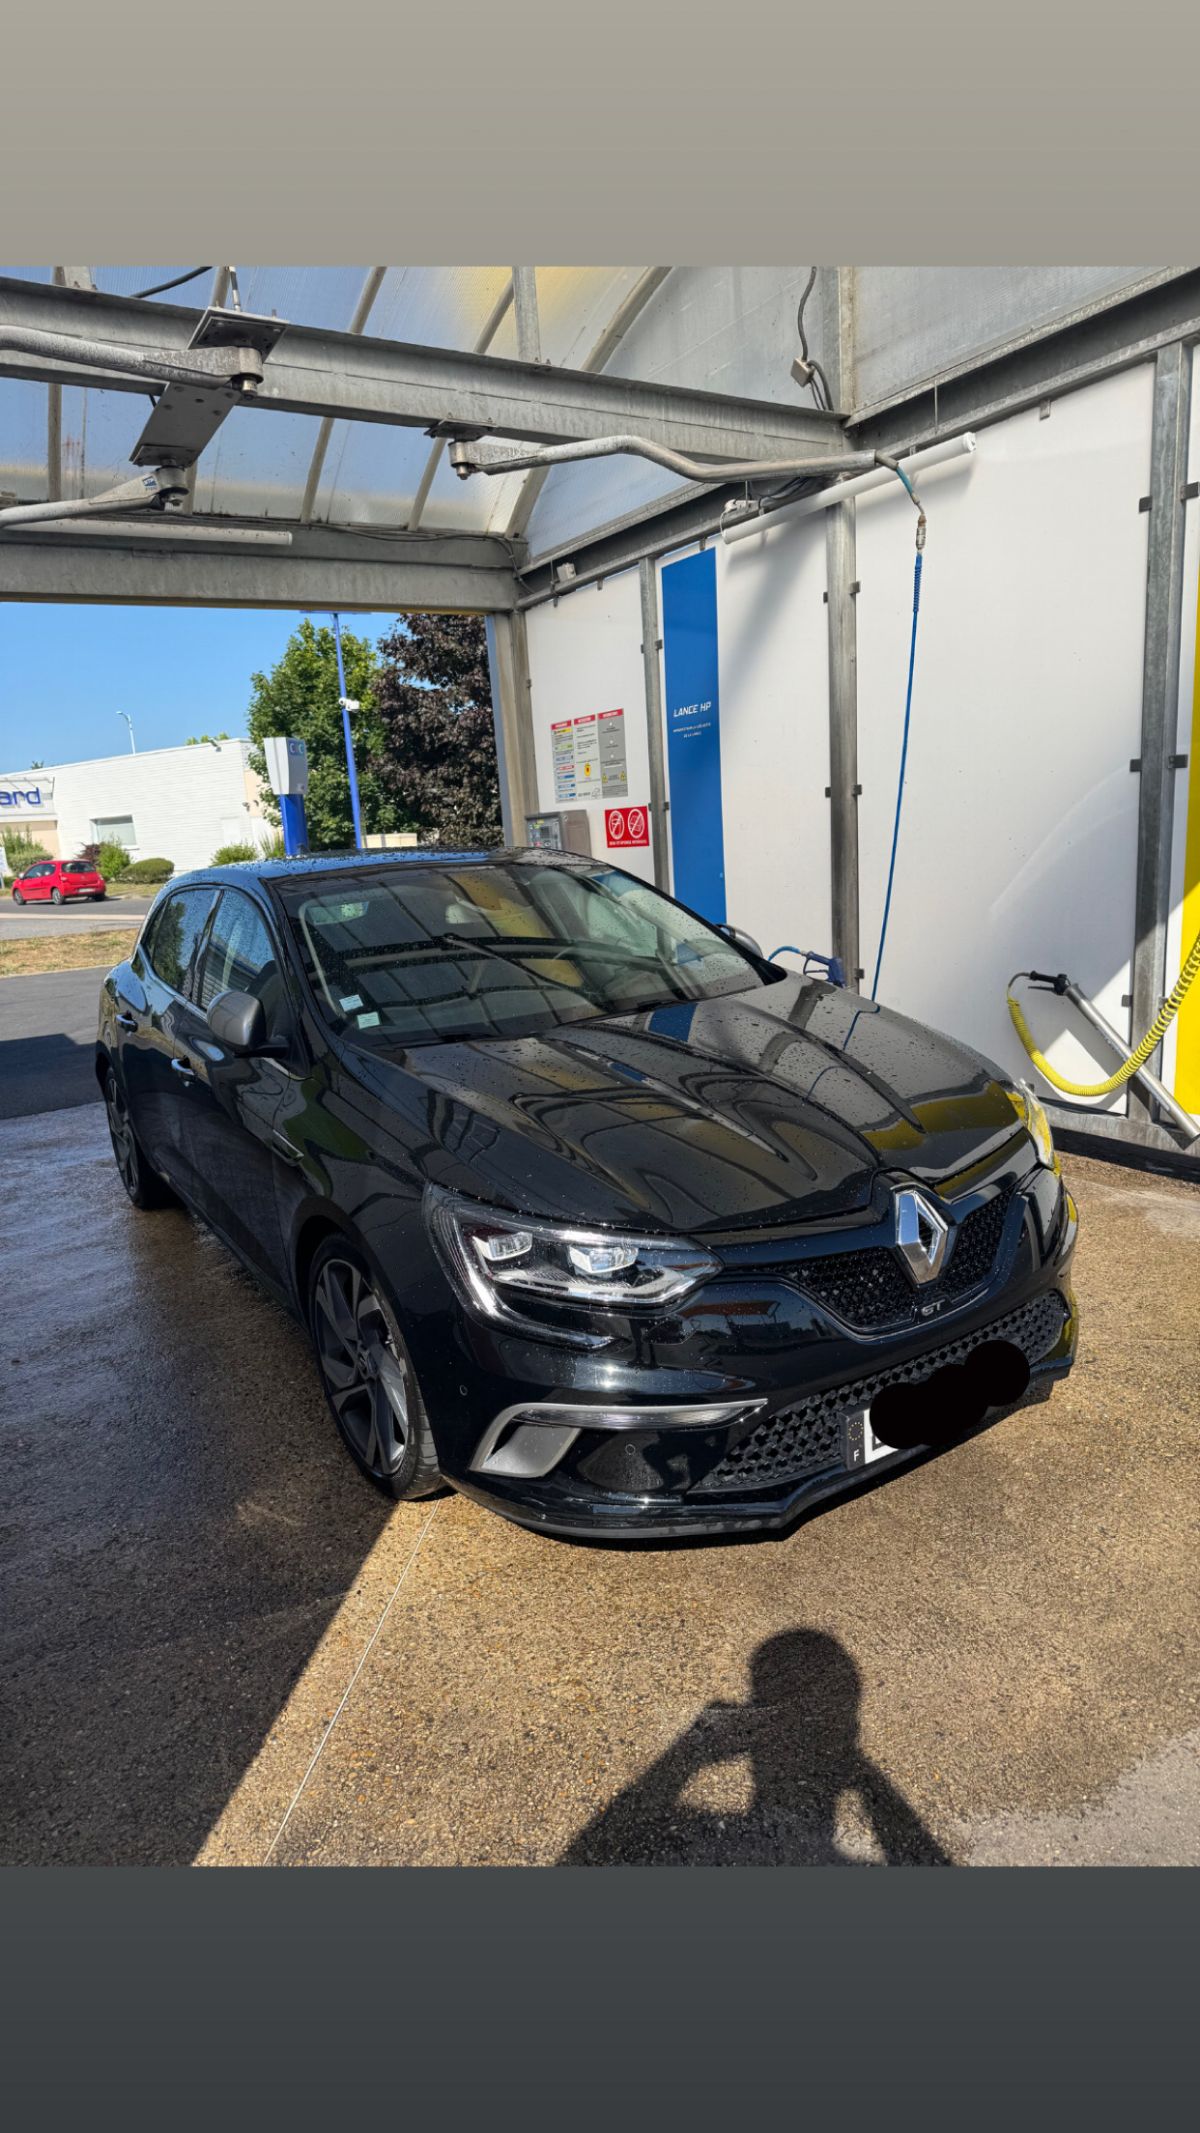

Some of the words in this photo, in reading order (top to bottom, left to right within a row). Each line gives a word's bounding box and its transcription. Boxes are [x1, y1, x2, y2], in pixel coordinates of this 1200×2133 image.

[673, 704, 698, 718] LANCE
[700, 701, 711, 712] HP
[0, 787, 41, 805] ard
[921, 1299, 945, 1316] GT
[854, 1449, 860, 1462] F
